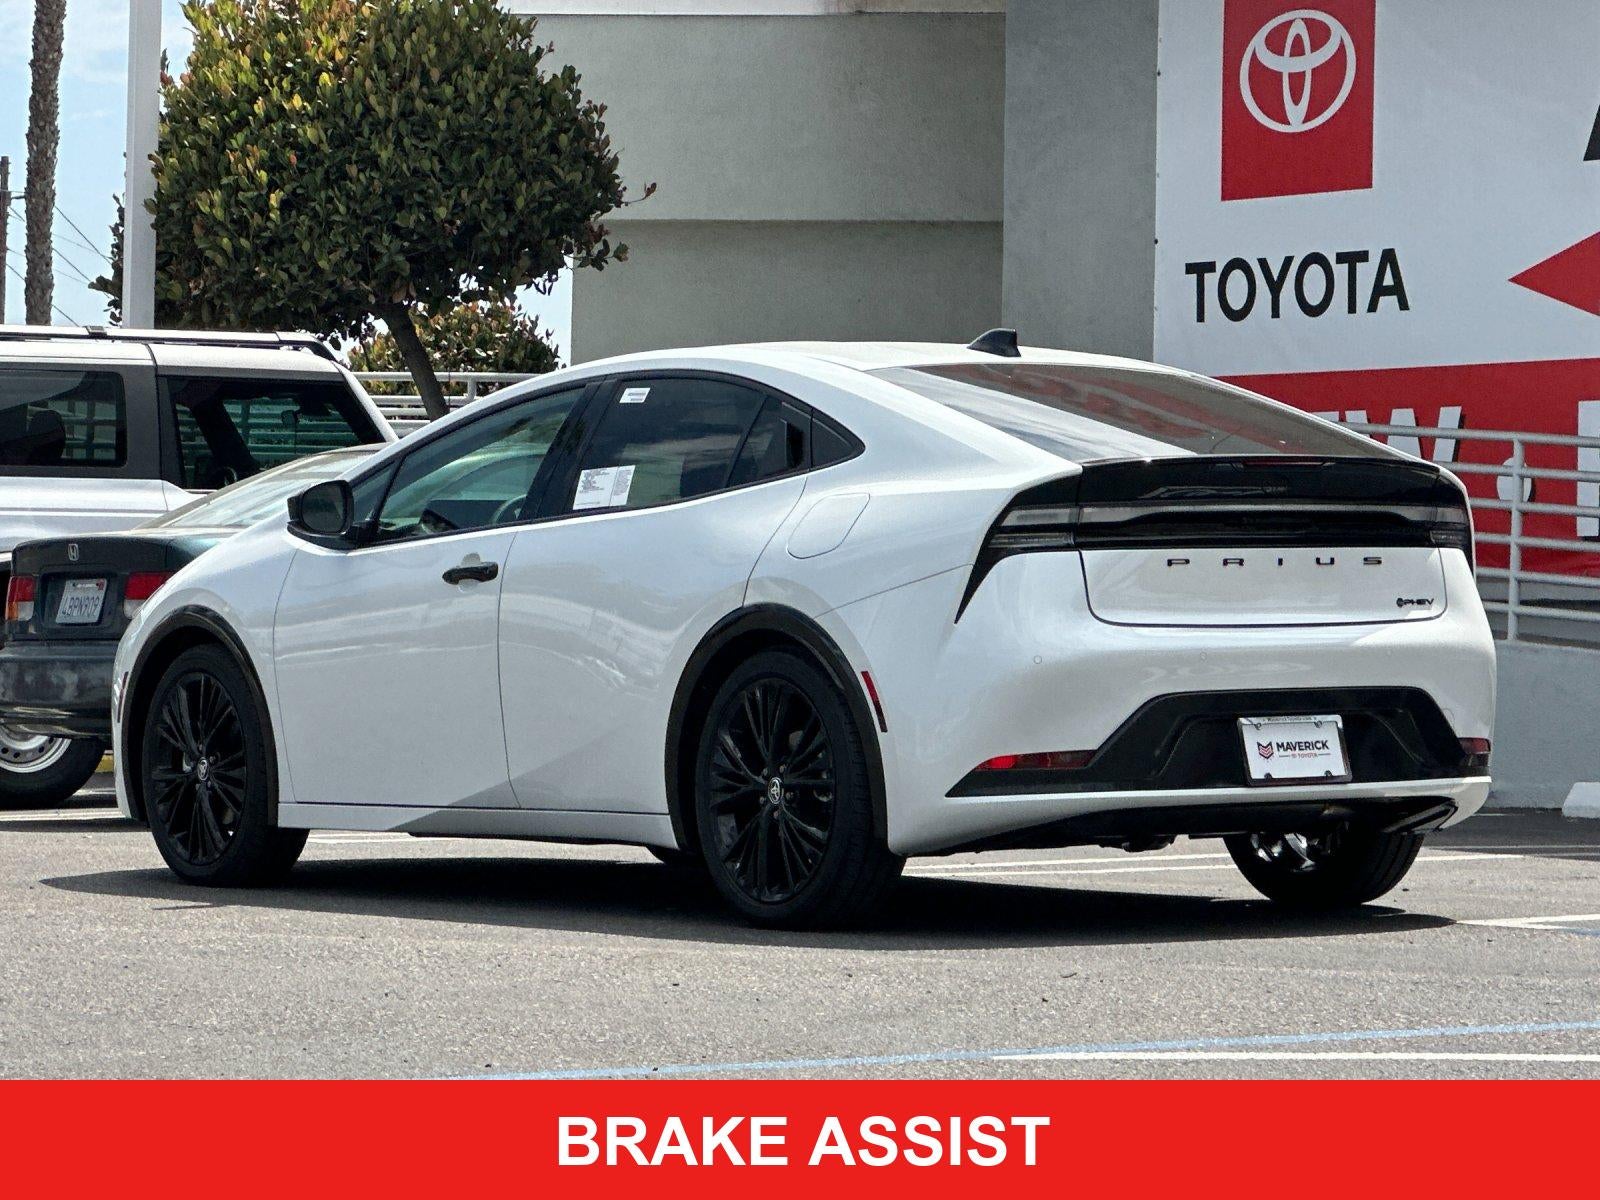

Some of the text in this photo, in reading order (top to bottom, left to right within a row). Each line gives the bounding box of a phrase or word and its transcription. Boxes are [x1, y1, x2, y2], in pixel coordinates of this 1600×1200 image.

[1185, 247, 1410, 323] TOYOTA
[1167, 557, 1382, 566] PRIUS
[1276, 740, 1329, 752] MAVERICK
